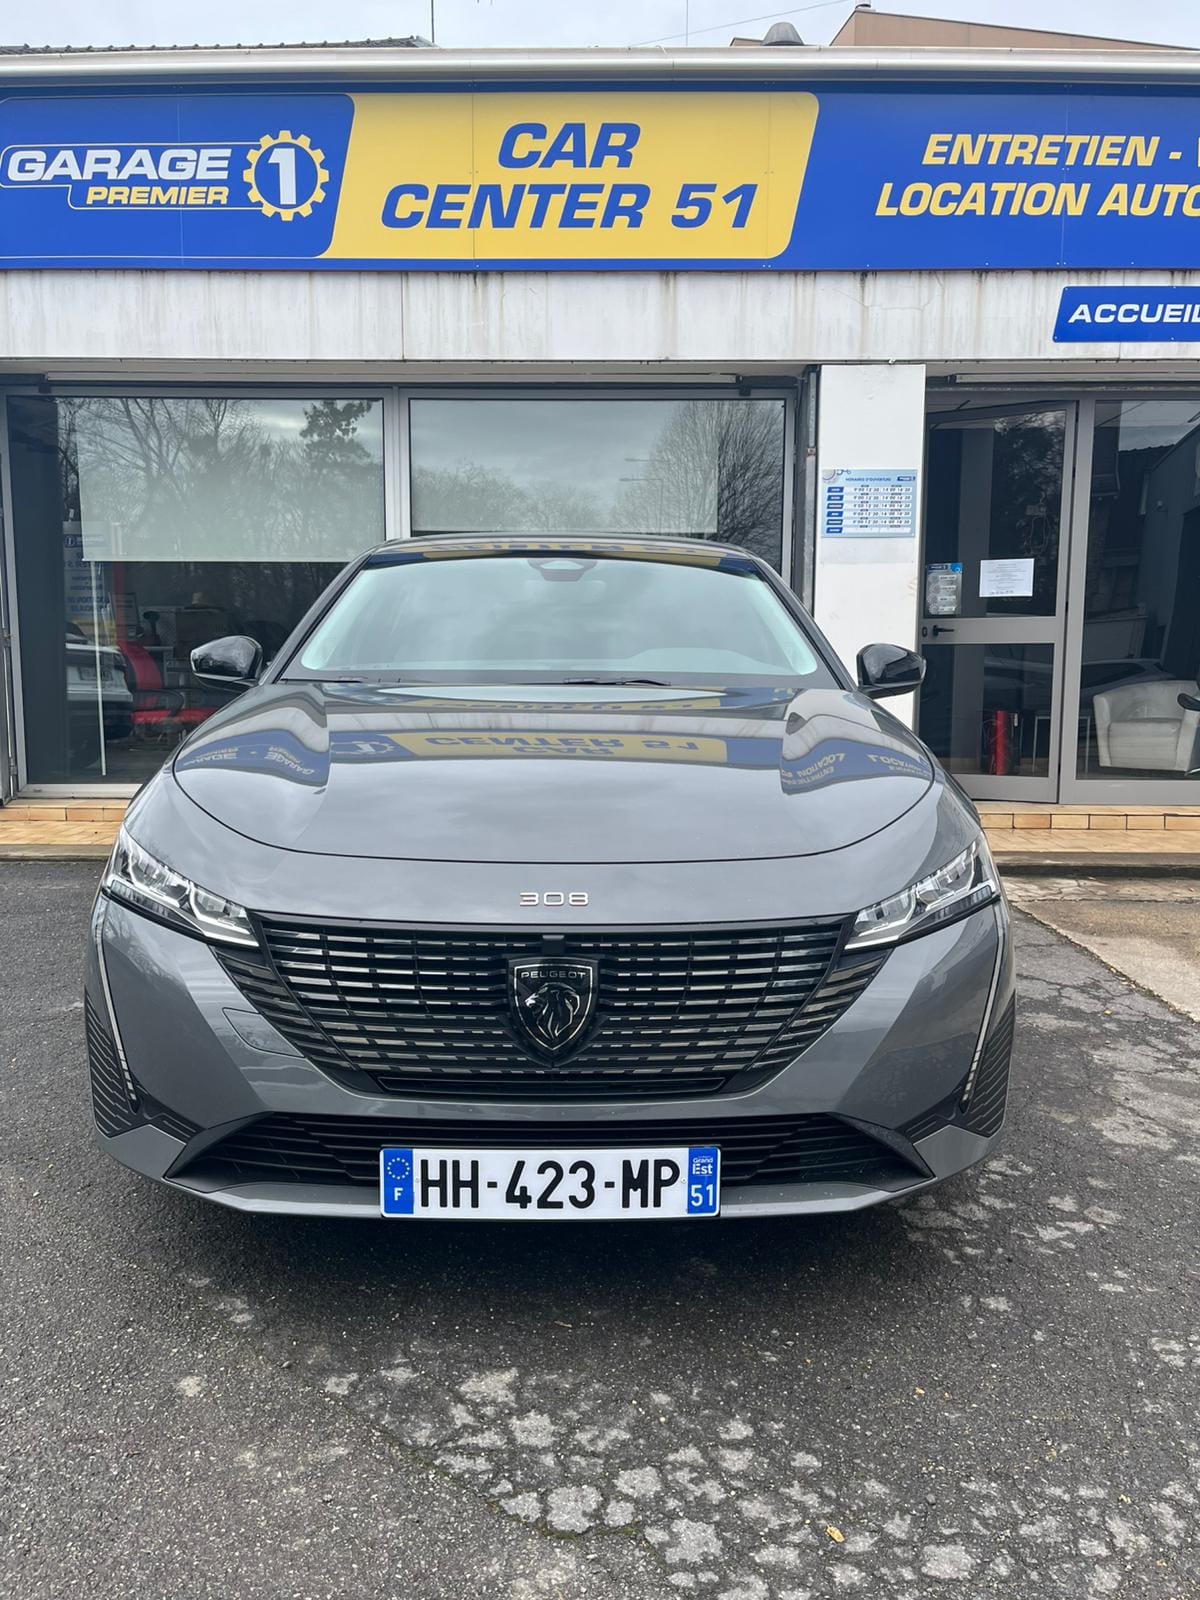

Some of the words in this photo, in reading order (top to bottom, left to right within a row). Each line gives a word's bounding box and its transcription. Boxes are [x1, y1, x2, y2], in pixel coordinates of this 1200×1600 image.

[497, 122, 641, 169] CAR
[922, 133, 1161, 167] ENTRETIEN
[1168, 151, 1182, 160] -
[7, 148, 232, 182] GARAGE
[267, 147, 297, 205] 1
[86, 186, 230, 205] PREMIER
[380, 183, 651, 230] CENTER
[671, 183, 758, 230] 51
[875, 181, 1091, 217] LOCATION
[519, 892, 589, 906] 308
[520, 971, 587, 979] PEUGEOT
[420, 1158, 681, 1209] HH-423-MP
[692, 1163, 714, 1175] Est
[394, 1187, 404, 1202] F
[691, 1184, 714, 1207] 51
